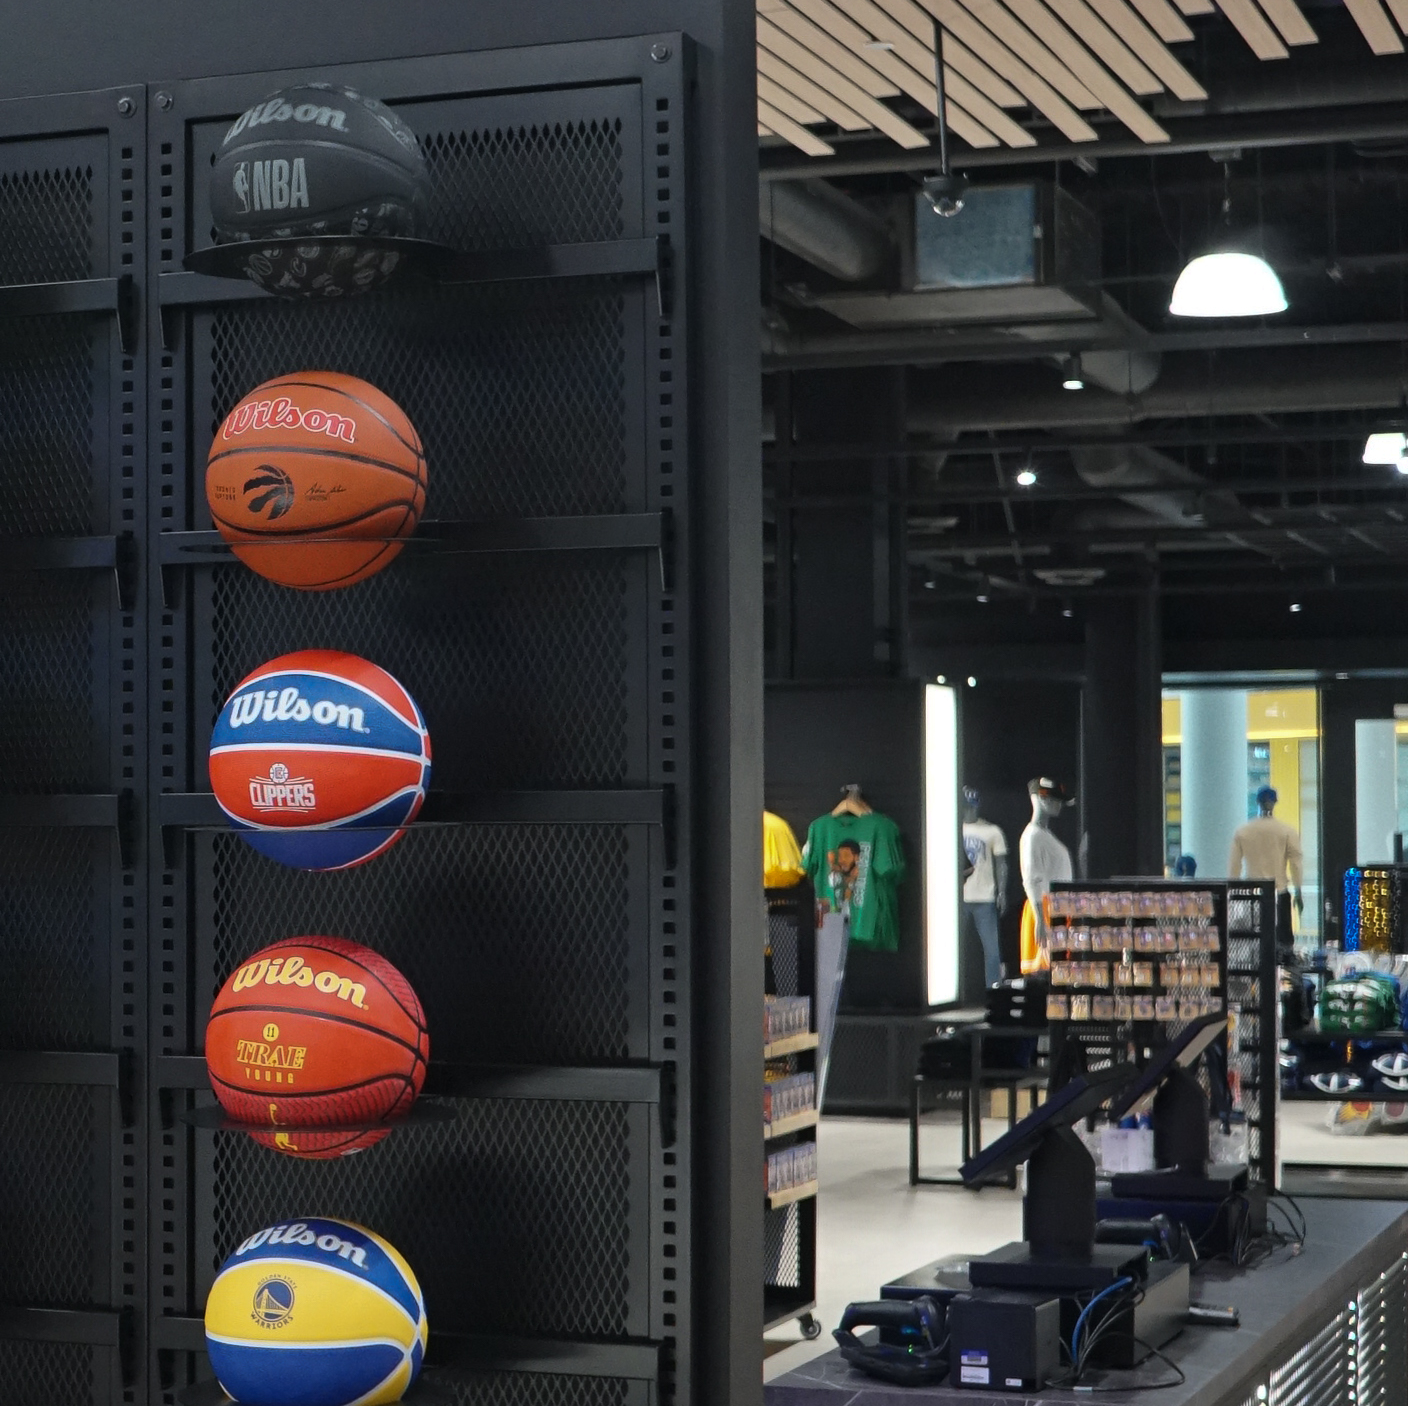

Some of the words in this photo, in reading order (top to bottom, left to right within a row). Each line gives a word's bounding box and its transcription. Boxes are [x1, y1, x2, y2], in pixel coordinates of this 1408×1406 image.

[252, 158, 309, 211] NBA
[222, 397, 356, 443] Wilson
[229, 687, 366, 733] Wilson
[248, 783, 316, 807] CLIPPERS
[232, 956, 367, 1009] Wilson
[237, 1040, 307, 1069] TRAE
[245, 1068, 294, 1084] YOUNG
[236, 1223, 368, 1268] Wilson
[250, 1311, 294, 1330] WARRIORS
